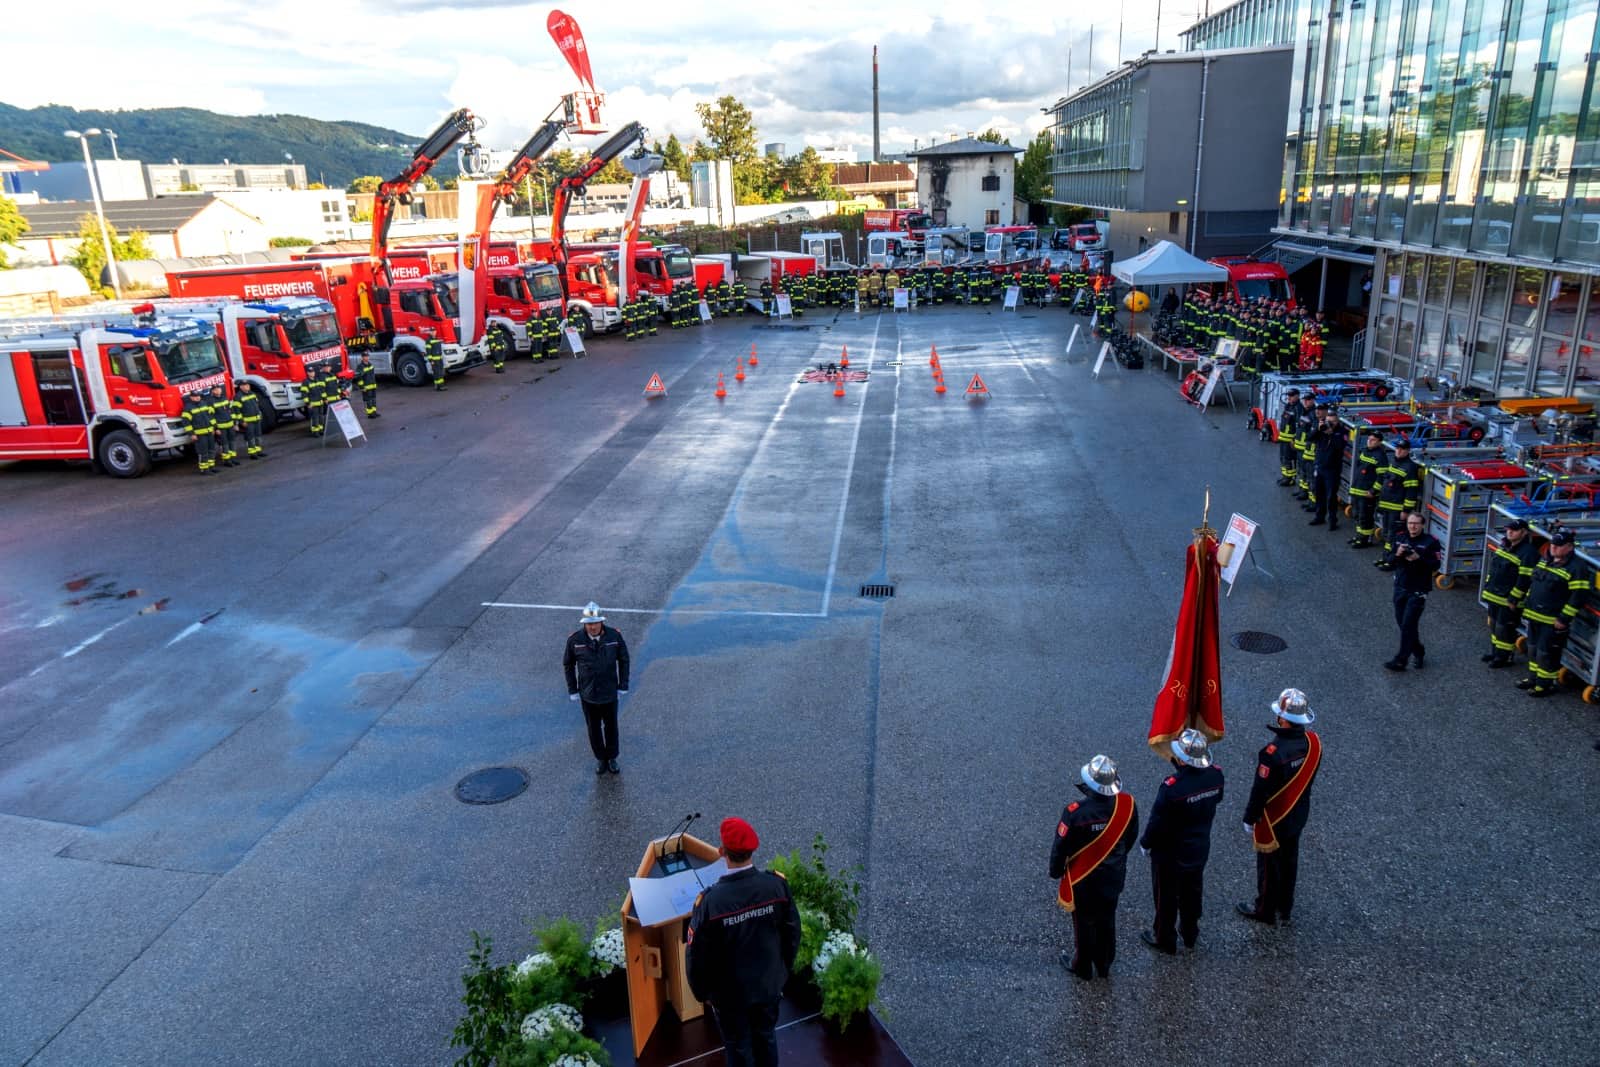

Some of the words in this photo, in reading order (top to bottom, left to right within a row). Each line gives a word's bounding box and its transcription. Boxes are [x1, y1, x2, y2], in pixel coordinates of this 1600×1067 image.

[243, 281, 316, 297] FEUERWEHR
[301, 347, 342, 363] FEUERWEHR
[178, 374, 226, 394] FEUERWEHR
[722, 904, 775, 928] FEUERWEHR
